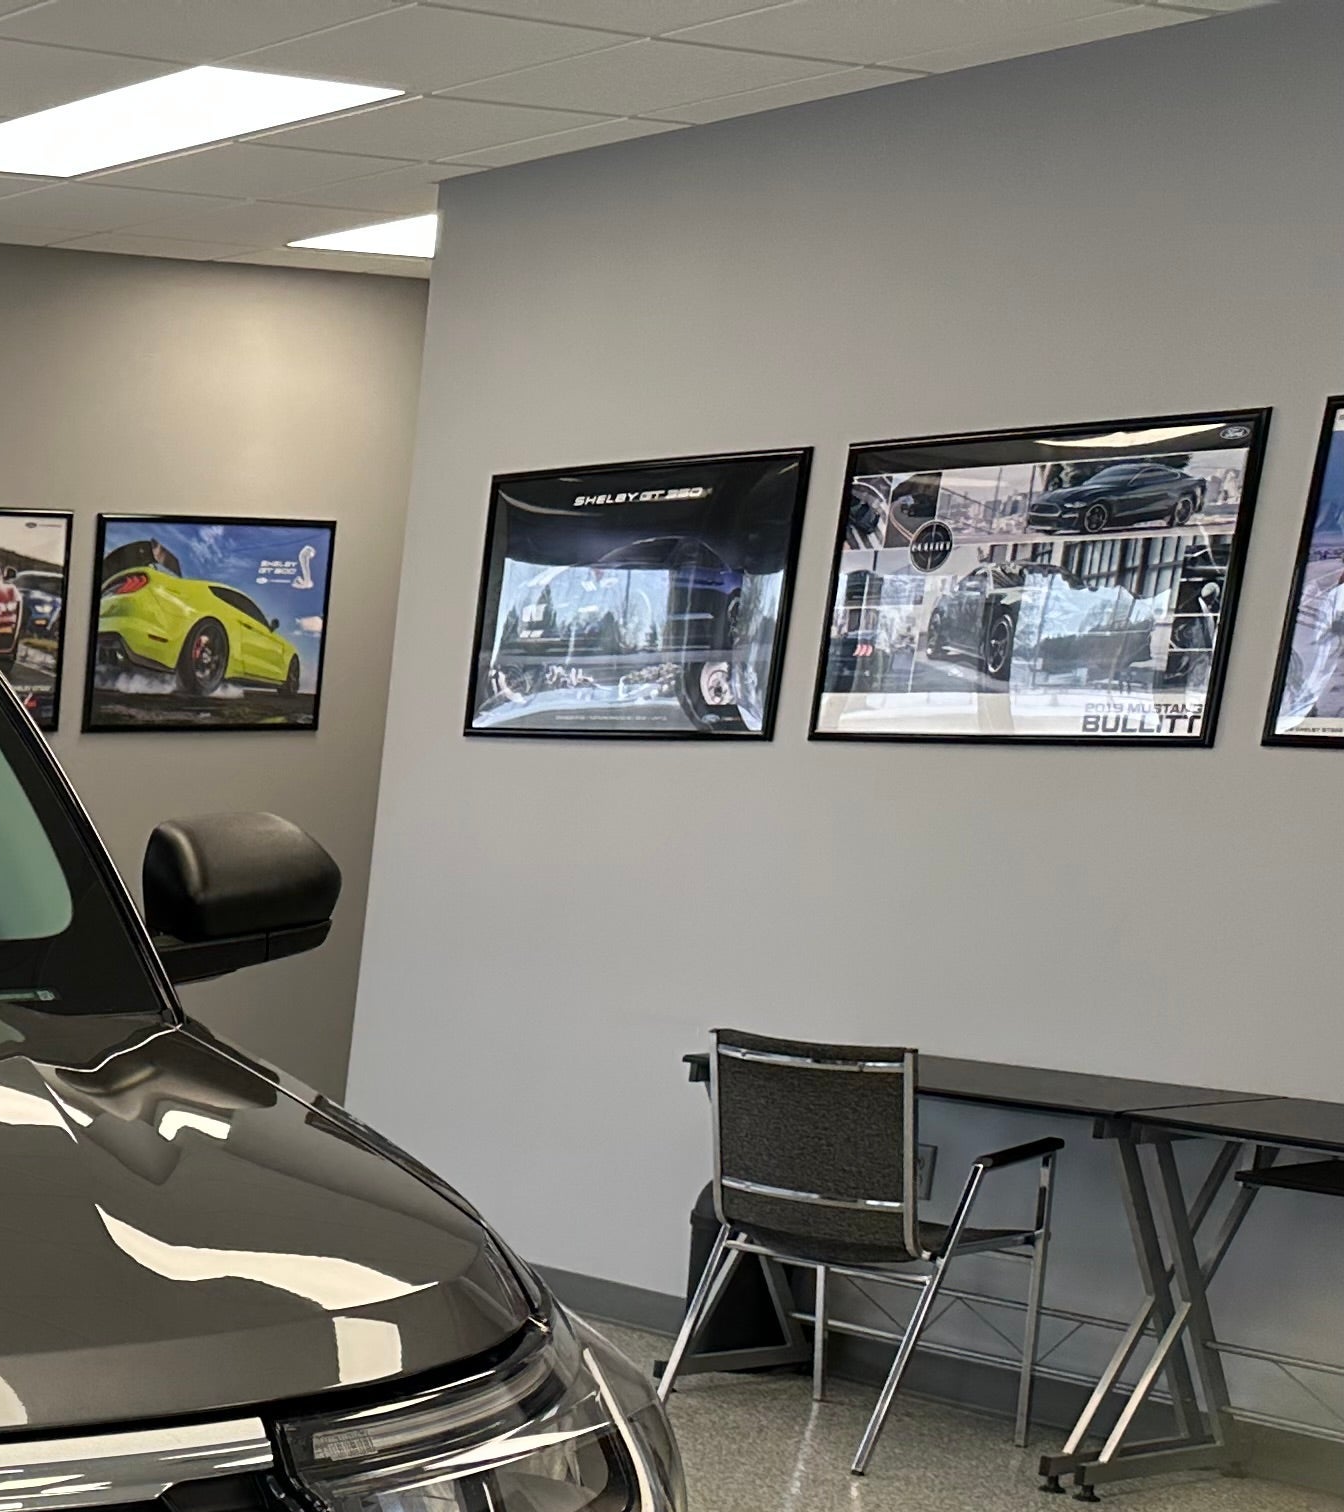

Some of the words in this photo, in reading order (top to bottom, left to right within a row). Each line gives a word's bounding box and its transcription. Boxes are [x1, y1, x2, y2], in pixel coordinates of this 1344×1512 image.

[573, 492, 639, 506] SHELBY
[1085, 703, 1123, 713] 2019
[1127, 703, 1204, 714] MUSTANG
[1082, 715, 1201, 733] BULLITT
